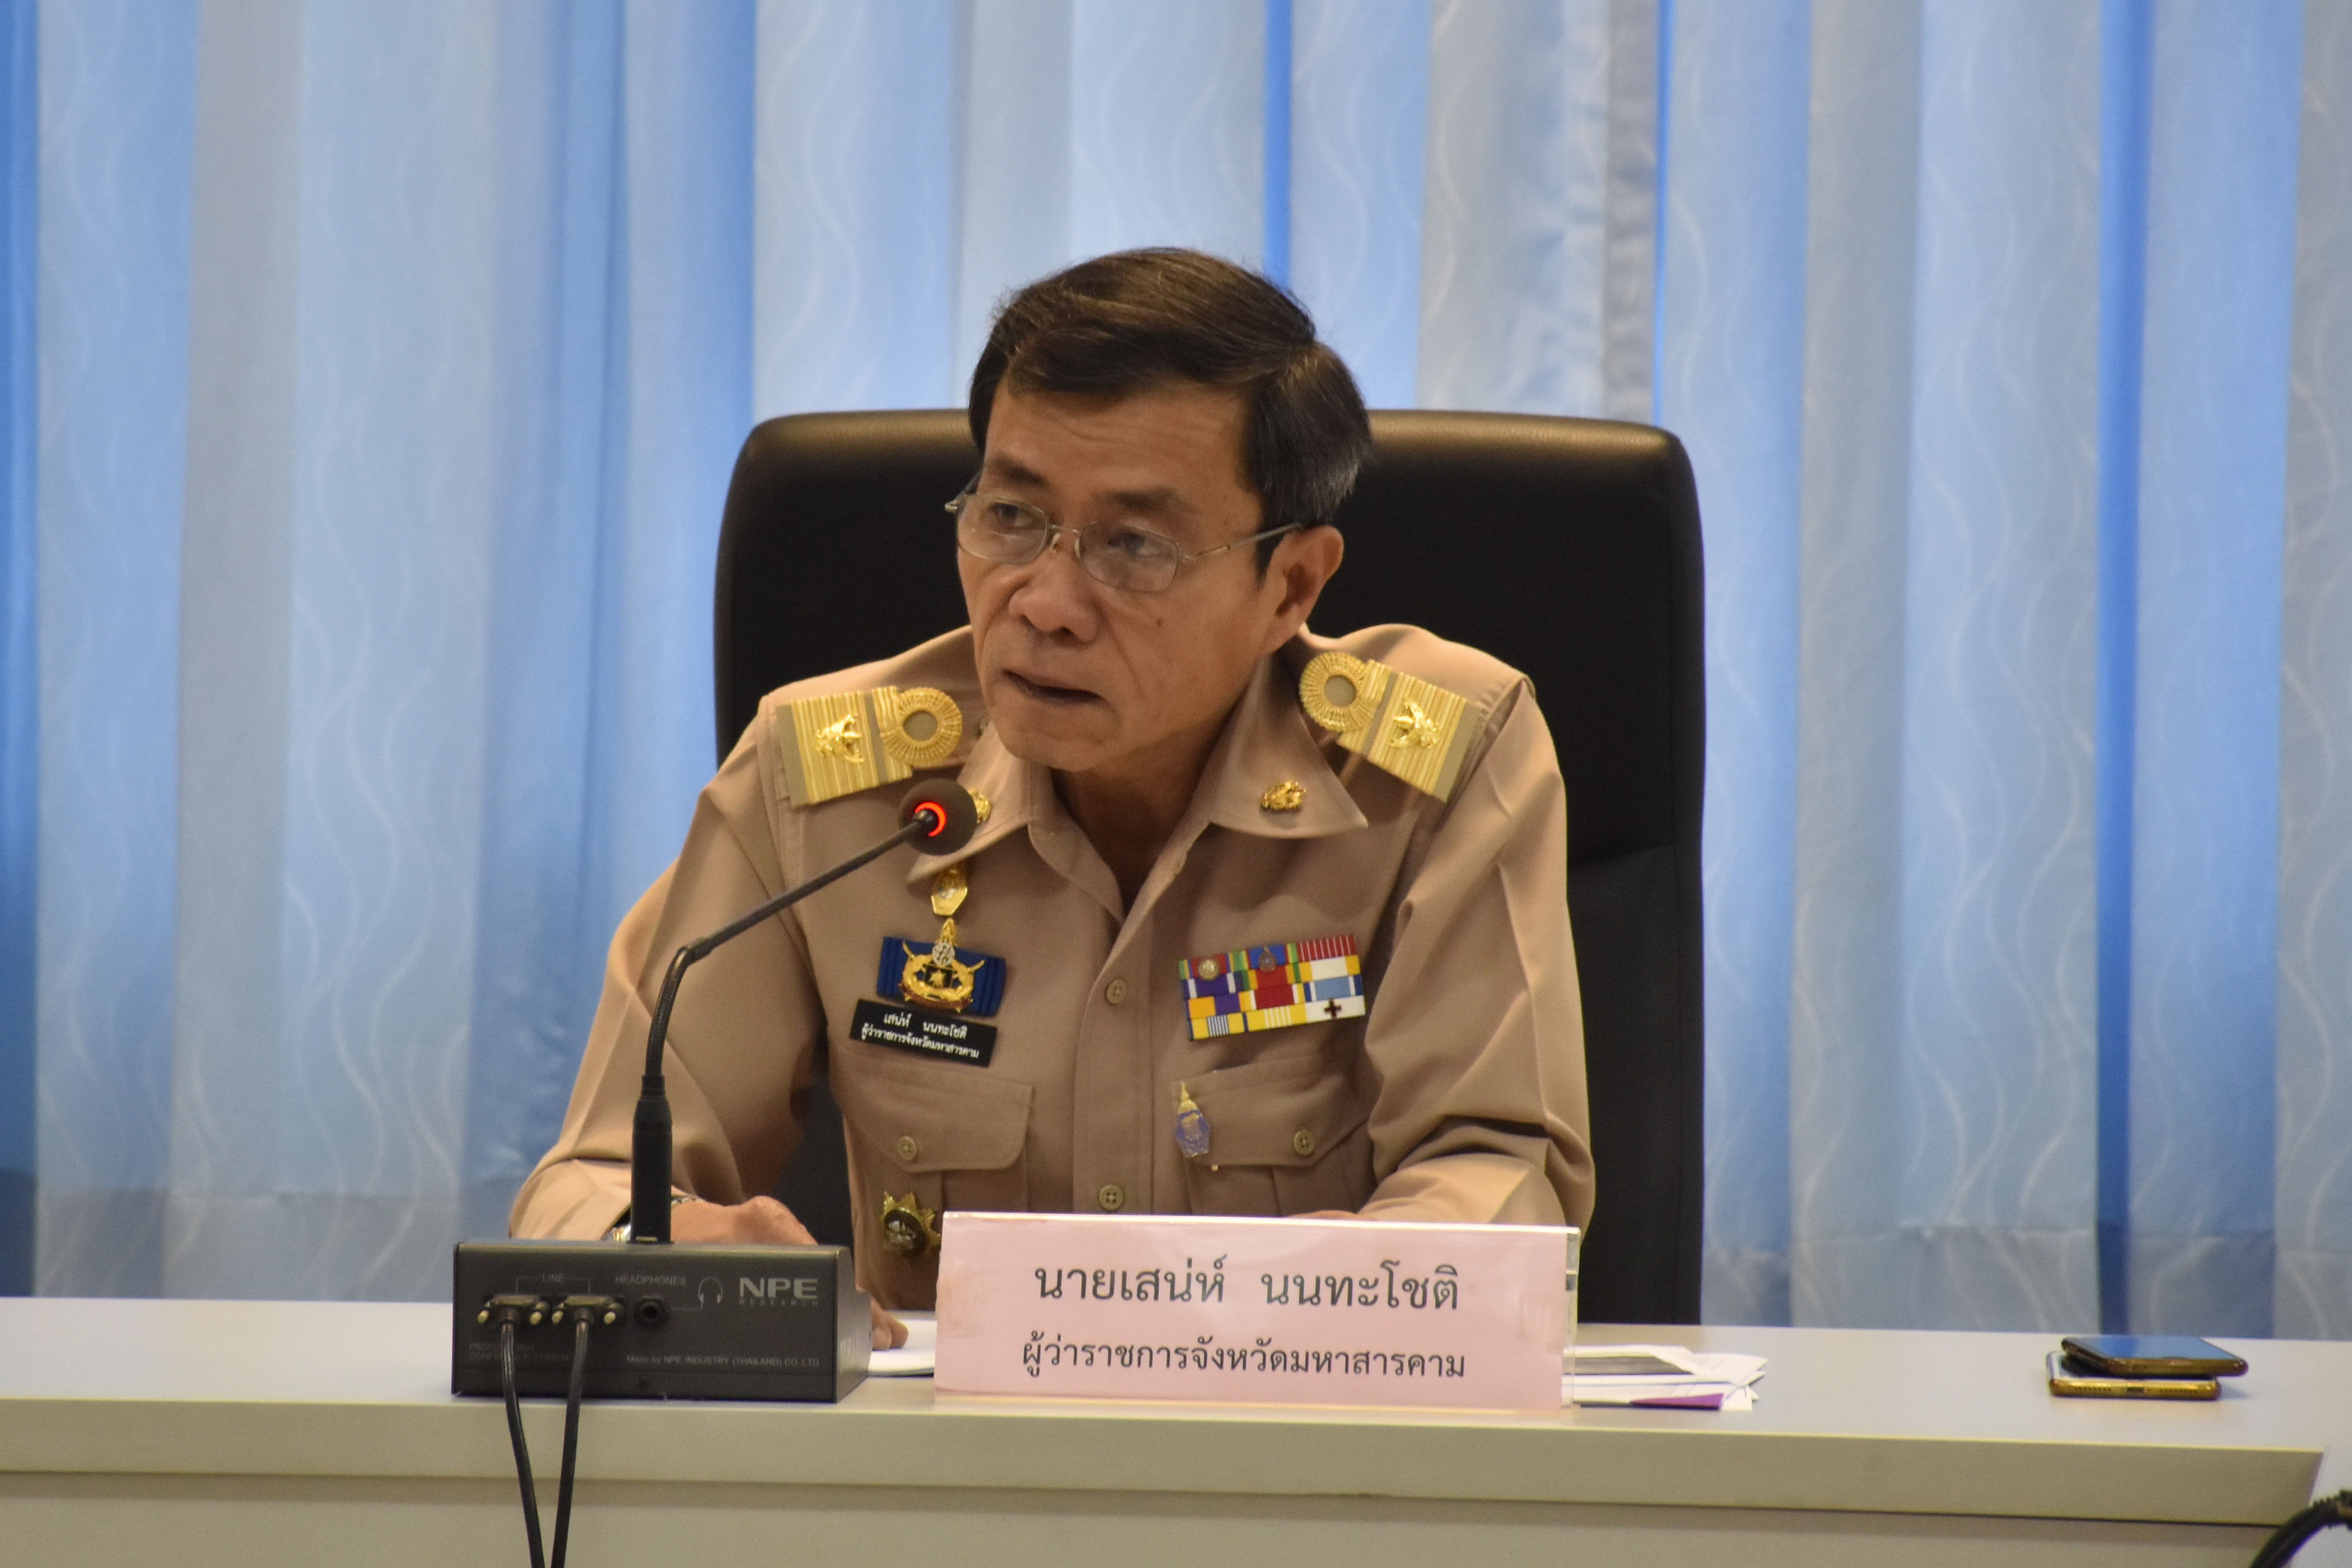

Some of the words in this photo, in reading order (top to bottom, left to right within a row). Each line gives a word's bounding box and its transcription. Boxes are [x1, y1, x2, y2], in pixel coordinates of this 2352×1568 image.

[883, 1012, 912, 1028] เสน่ห์
[542, 1273, 564, 1283] LINE
[615, 1275, 686, 1286] HEADPHONES
[1034, 1253, 1227, 1302] นายเสน่ห์
[1261, 1259, 1458, 1310] นนทะโชติ
[739, 1277, 818, 1299] NPE
[1022, 1330, 1465, 1378] ผู้ว่าราชการจังหวัดมหาสารคาม
